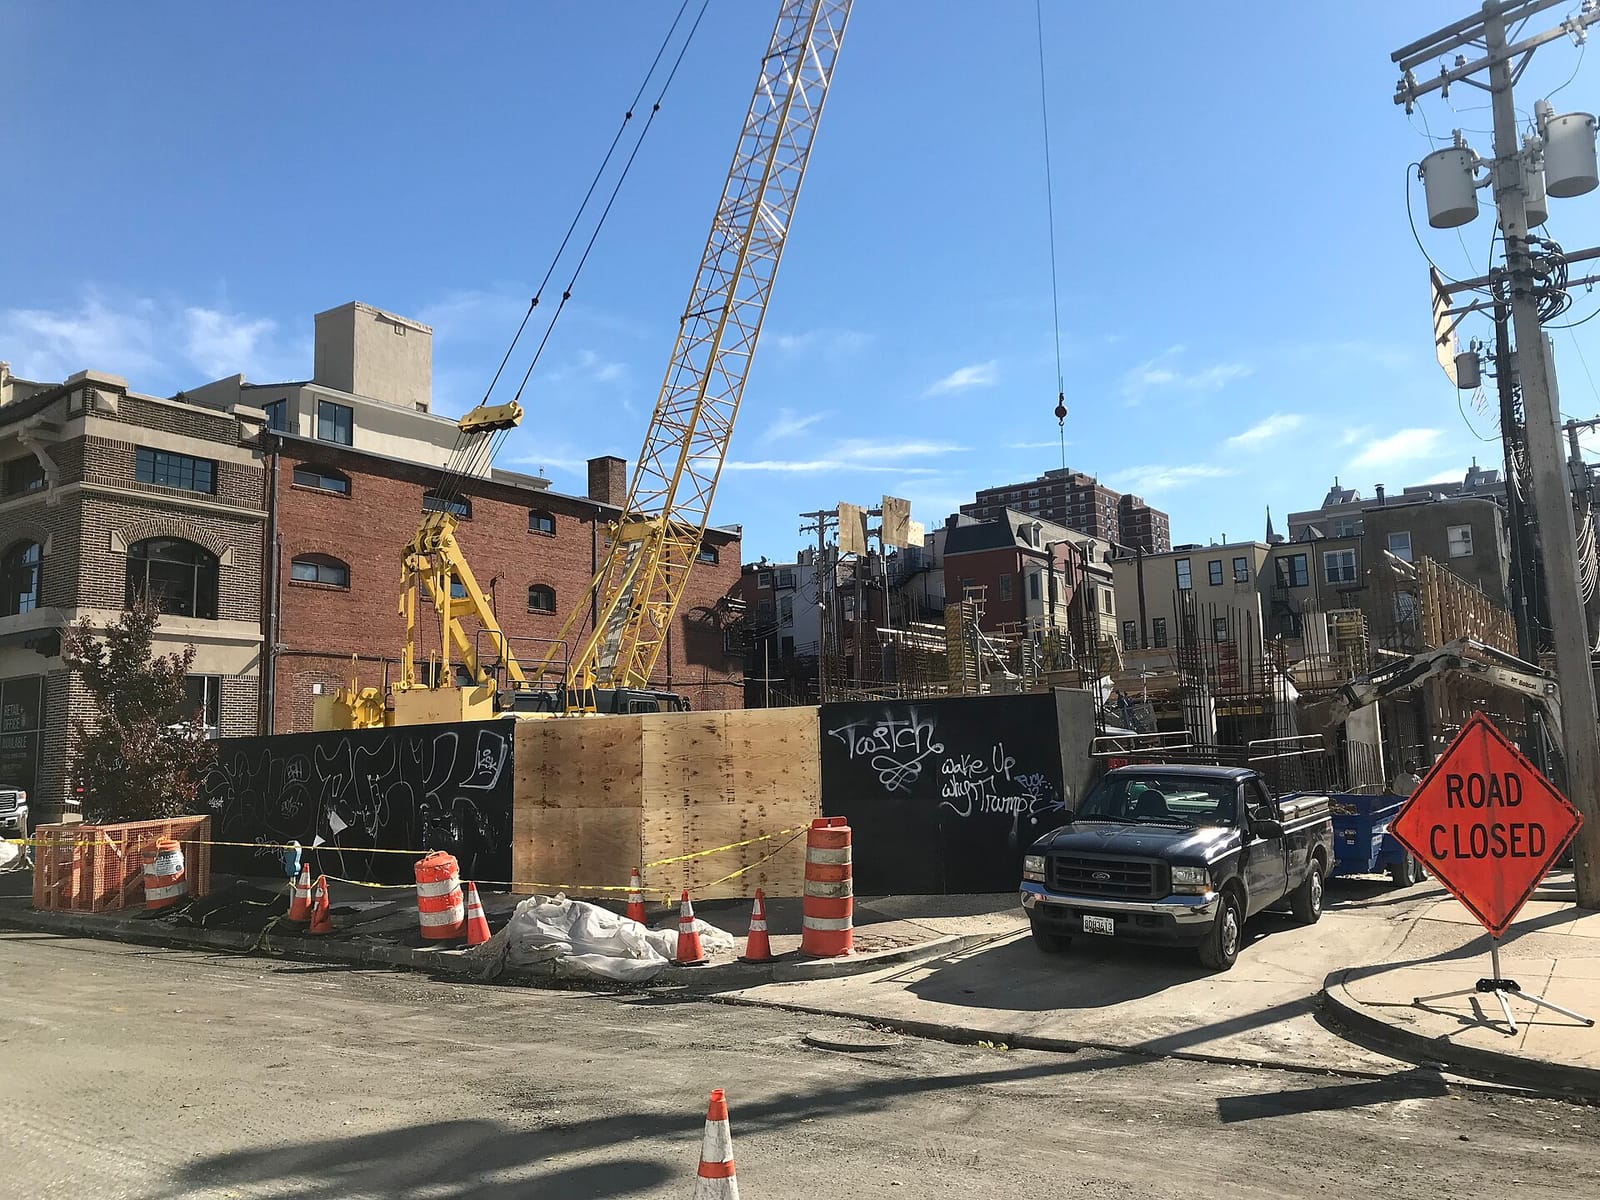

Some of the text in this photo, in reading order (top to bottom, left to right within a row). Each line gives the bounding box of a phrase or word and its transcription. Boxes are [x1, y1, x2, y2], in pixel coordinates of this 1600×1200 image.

[1518, 679, 1537, 690] Bobcat
[1446, 772, 1523, 809] ROAD
[1429, 822, 1546, 861] CLOSED
